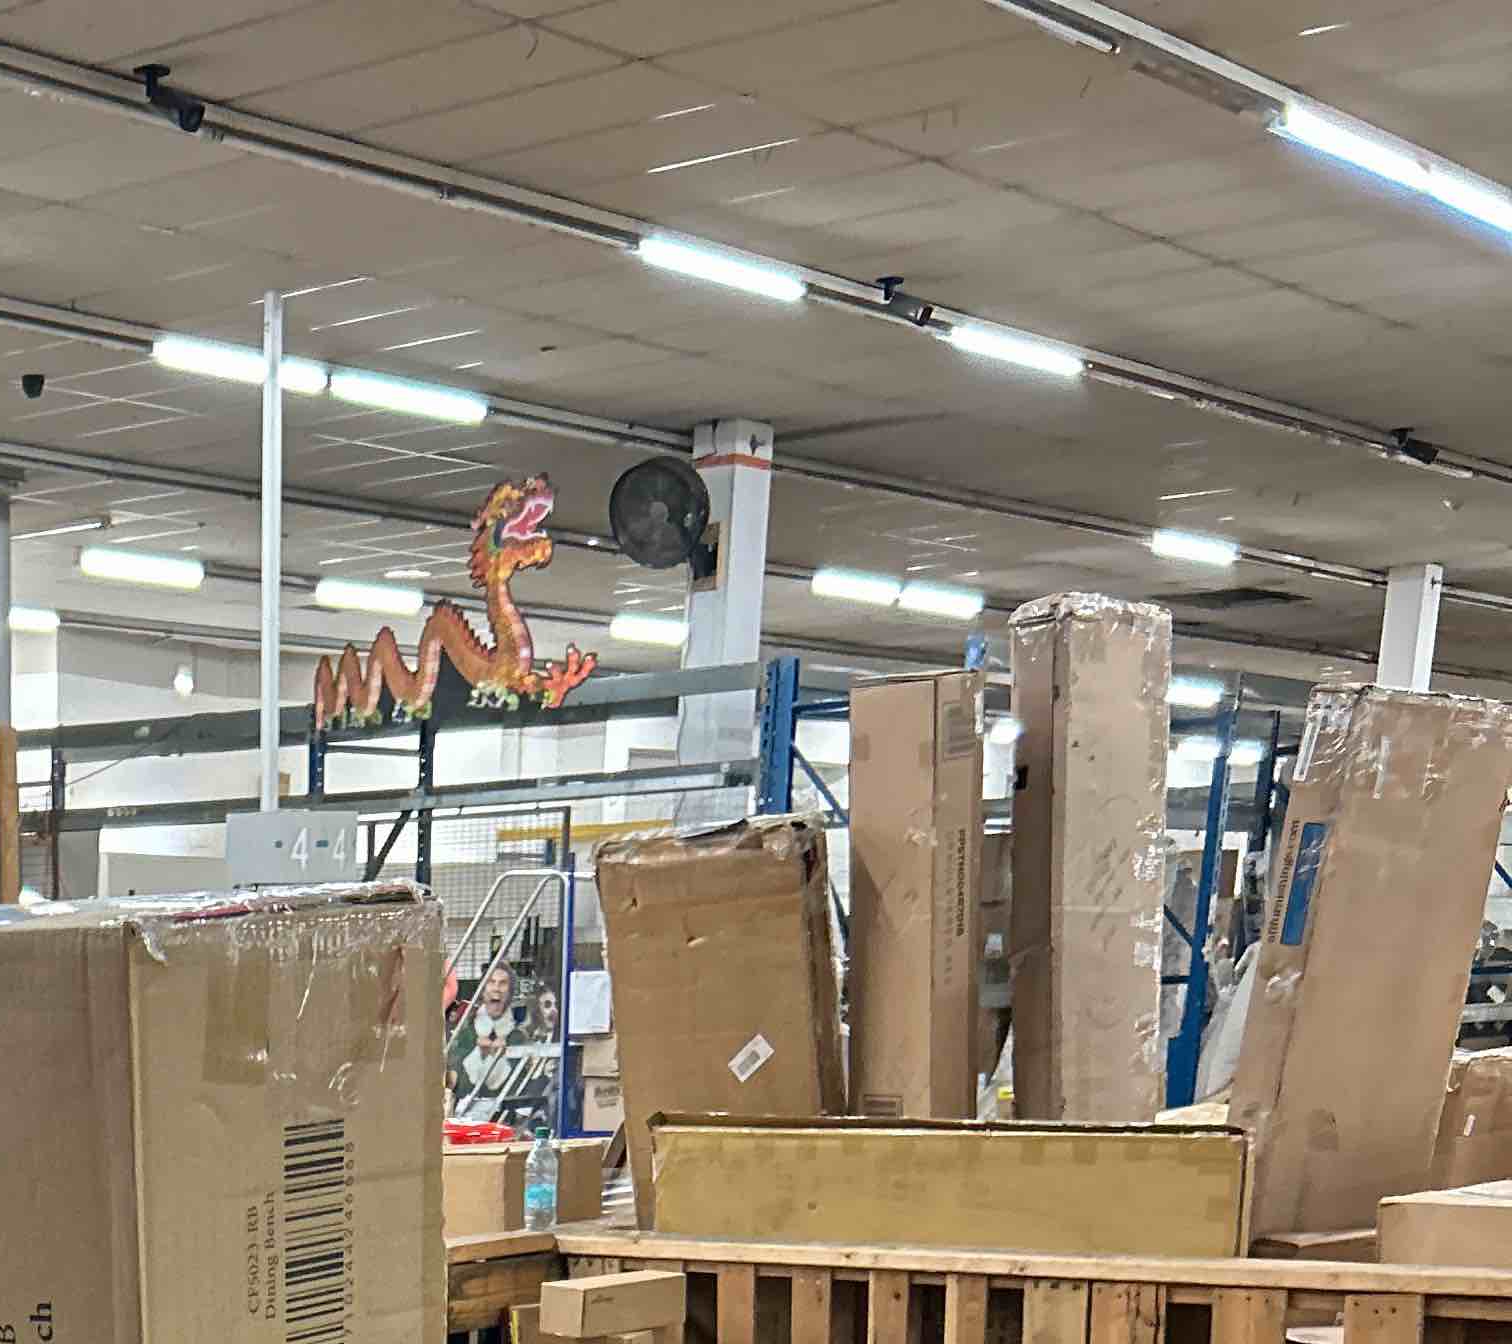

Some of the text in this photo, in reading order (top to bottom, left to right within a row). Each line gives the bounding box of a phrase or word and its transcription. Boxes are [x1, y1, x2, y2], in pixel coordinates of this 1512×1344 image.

[290, 827, 309, 871] 4
[263, 1192, 278, 1320] Dining Bench
